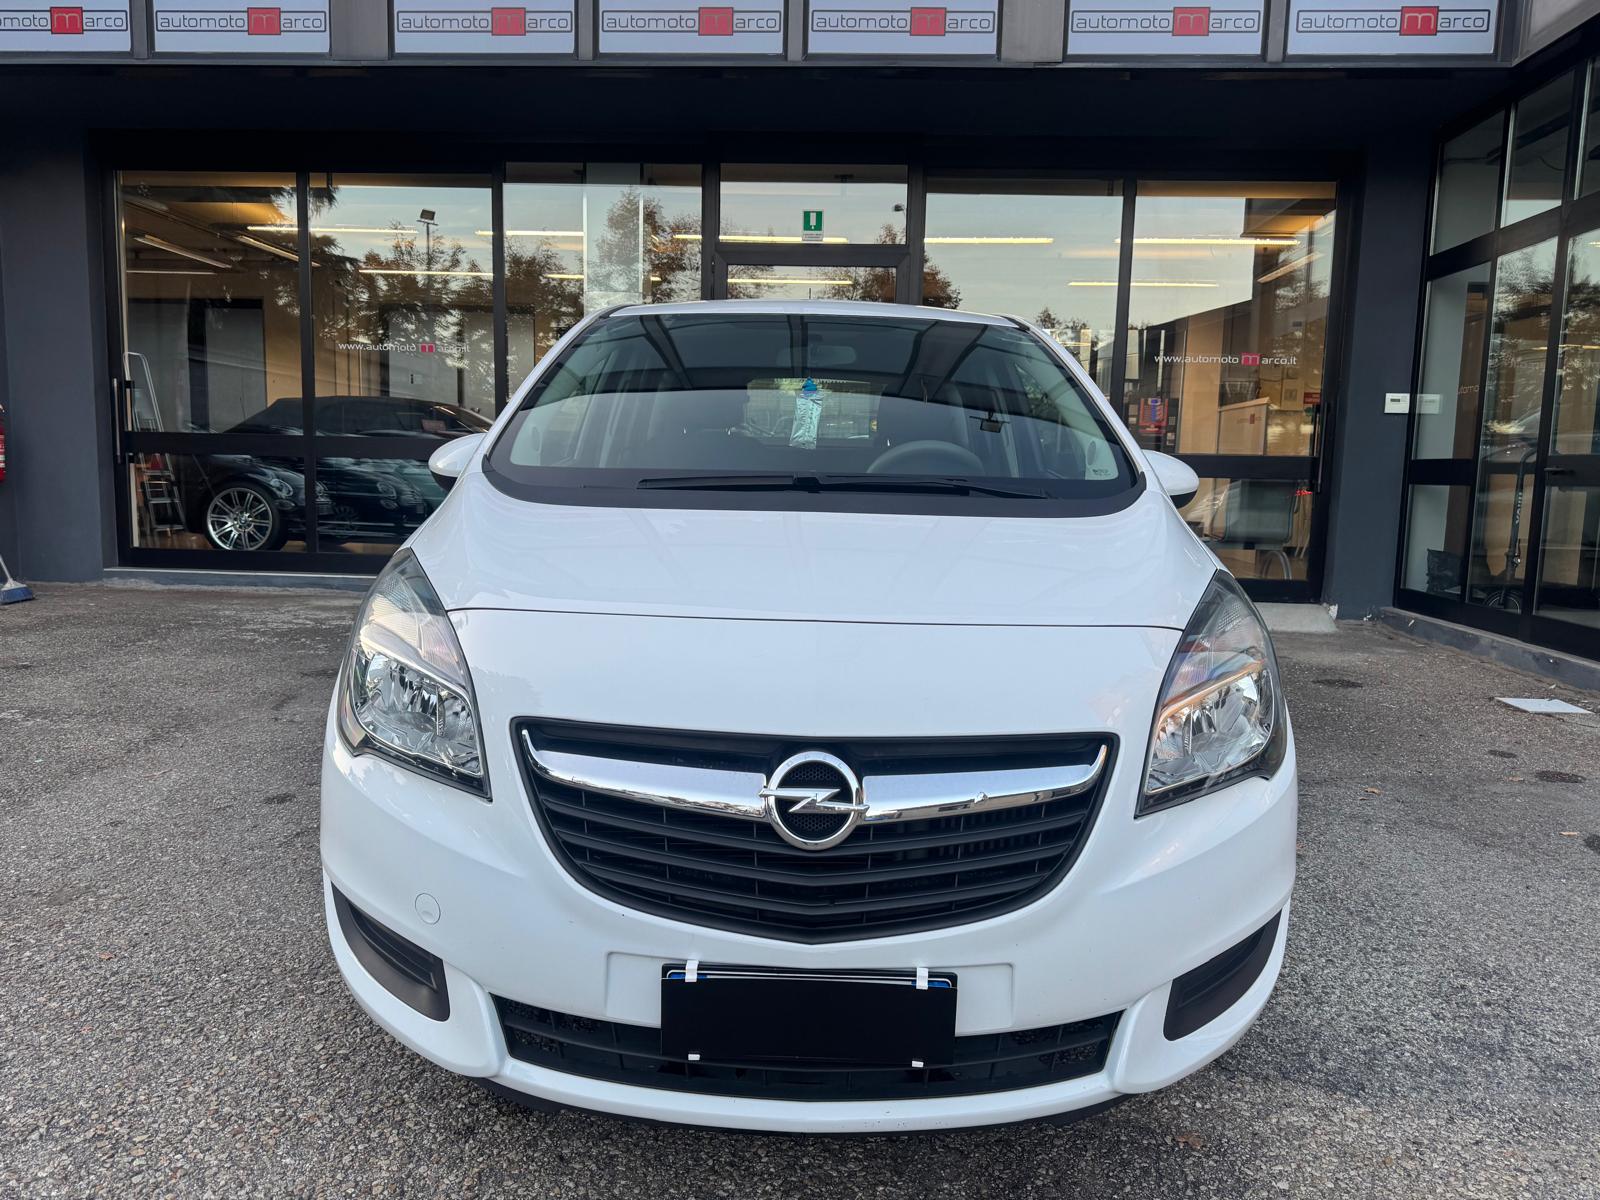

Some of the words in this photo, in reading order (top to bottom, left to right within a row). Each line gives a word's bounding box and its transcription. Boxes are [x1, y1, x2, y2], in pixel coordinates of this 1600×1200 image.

[0, 13, 49, 28] moto
[160, 14, 246, 29] automoto
[401, 15, 490, 29] automoto
[606, 14, 696, 29] automoto
[816, 14, 908, 29] automoto
[1075, 15, 1170, 29] automoto
[1301, 14, 1398, 28] automoto
